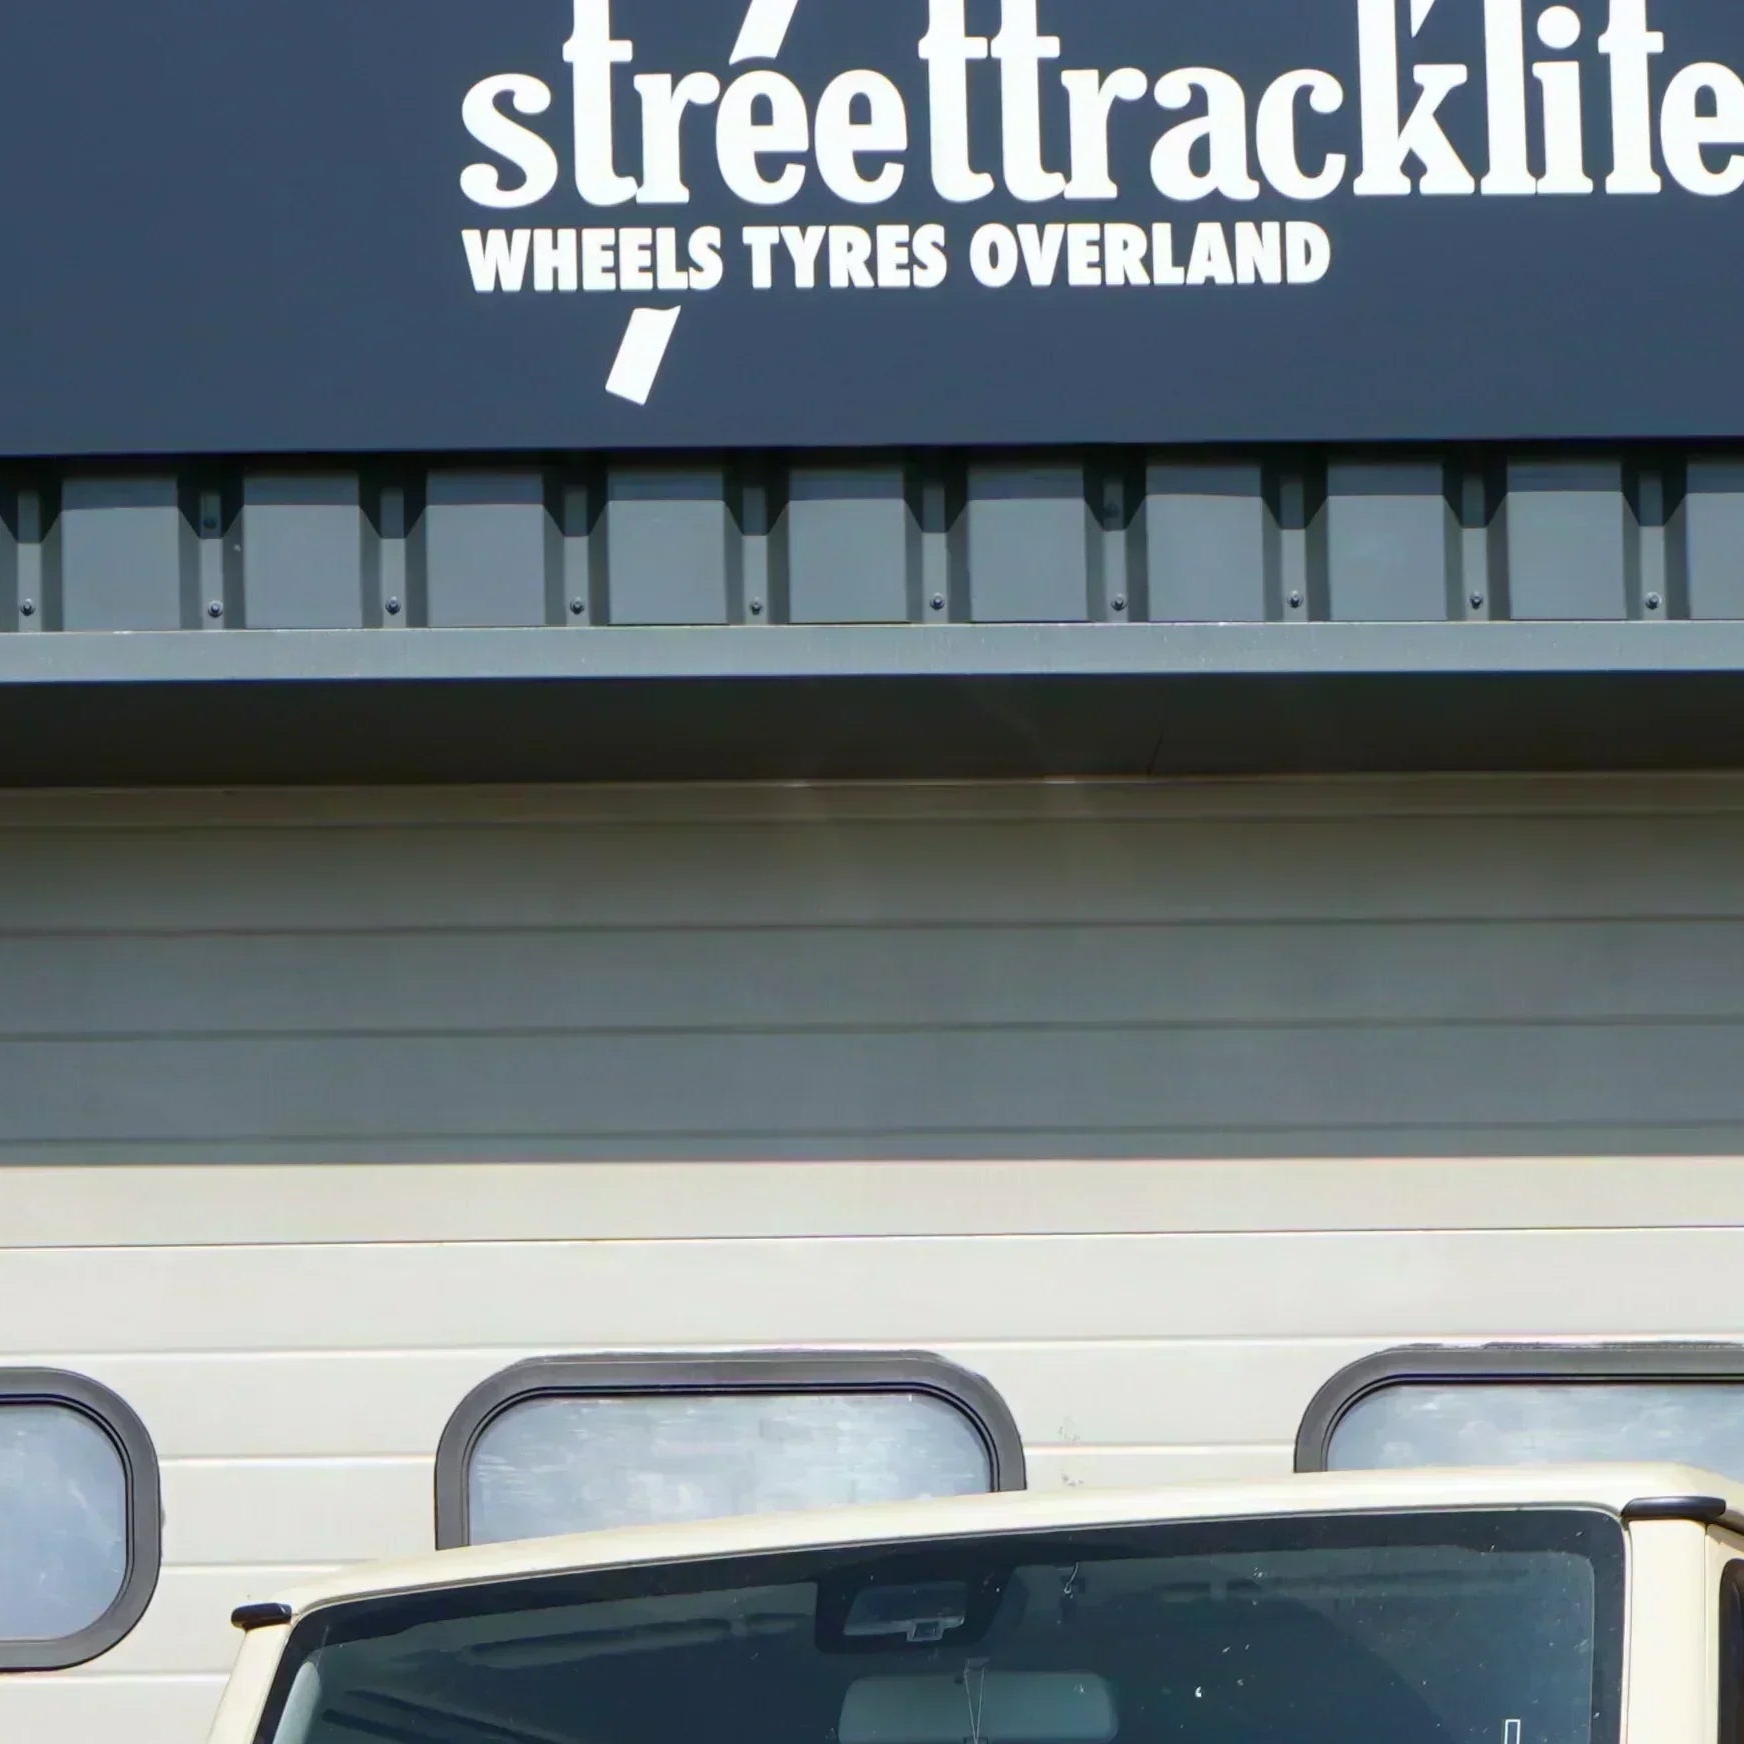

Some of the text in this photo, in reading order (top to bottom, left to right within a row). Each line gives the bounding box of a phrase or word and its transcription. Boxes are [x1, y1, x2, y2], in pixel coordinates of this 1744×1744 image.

[461, 220, 1331, 292] WHEELS TYRES OVERLAND
